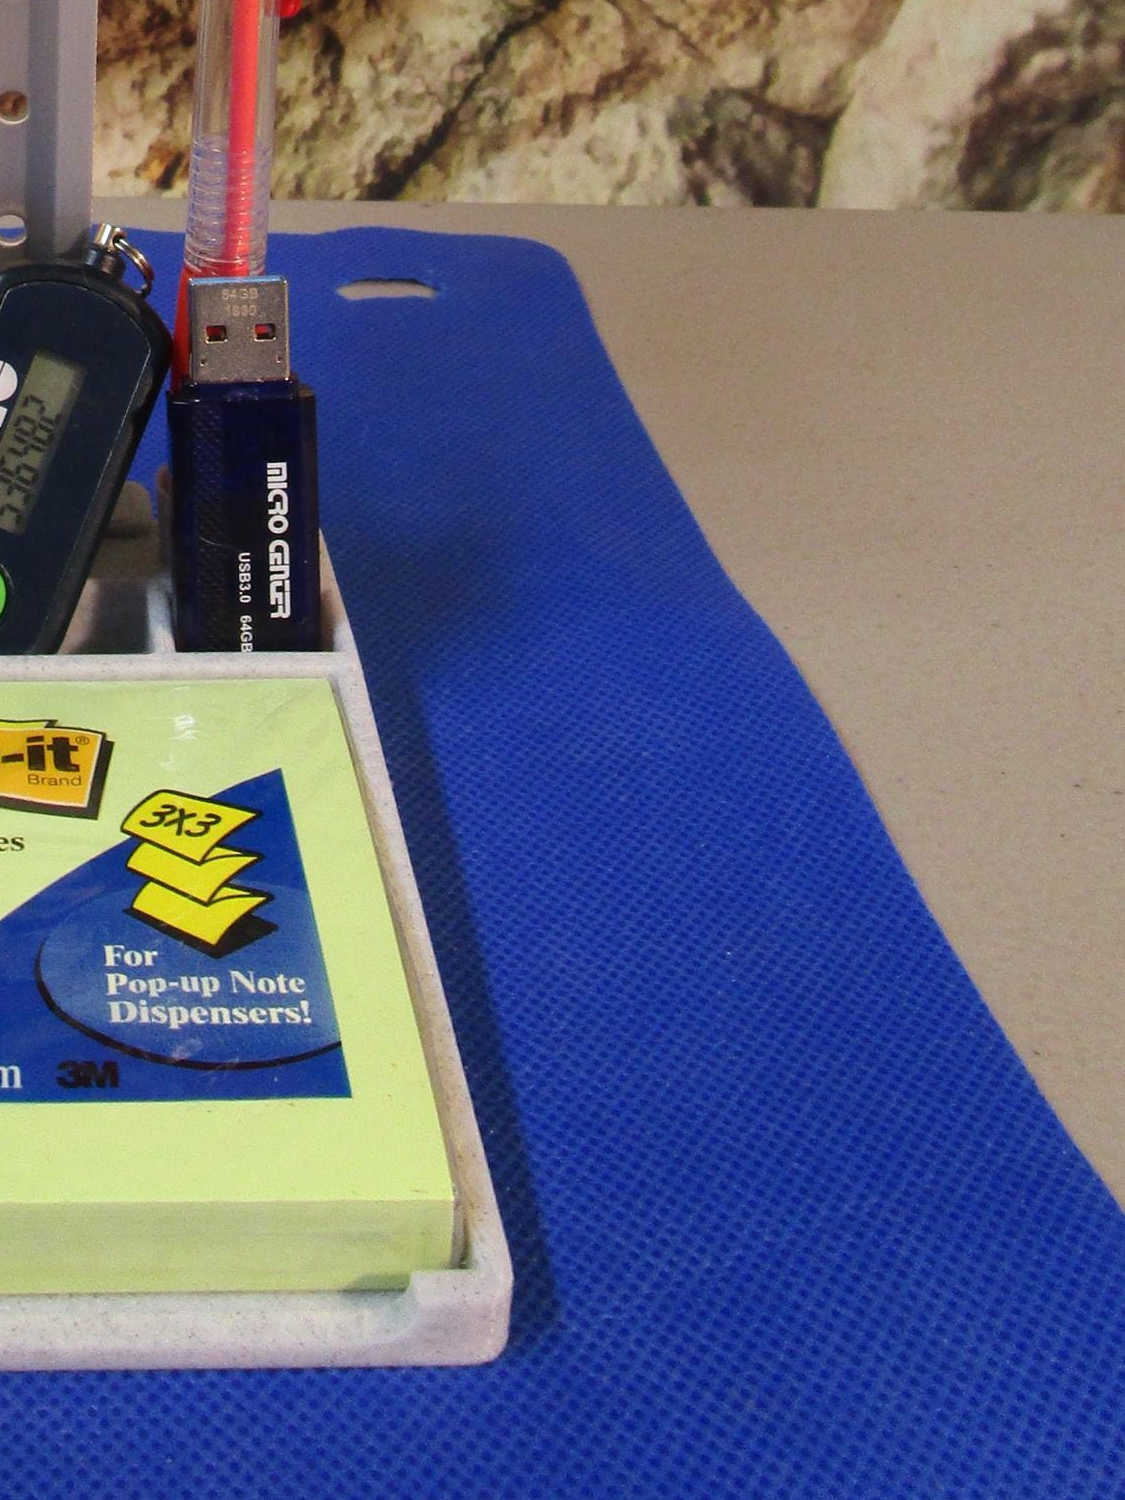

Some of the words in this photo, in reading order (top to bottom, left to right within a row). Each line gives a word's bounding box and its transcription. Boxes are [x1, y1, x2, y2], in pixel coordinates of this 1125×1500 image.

[266, 461, 289, 535] MICRO
[238, 552, 252, 603] USB3.0
[268, 539, 291, 619] CENTER
[240, 615, 253, 652] 64GB
[27, 774, 83, 787] Brand
[104, 945, 159, 967] For
[106, 973, 220, 998] Pop-up
[229, 970, 307, 994] Note
[109, 1000, 313, 1030] Dispensers!
[56, 1060, 119, 1089] 3M
